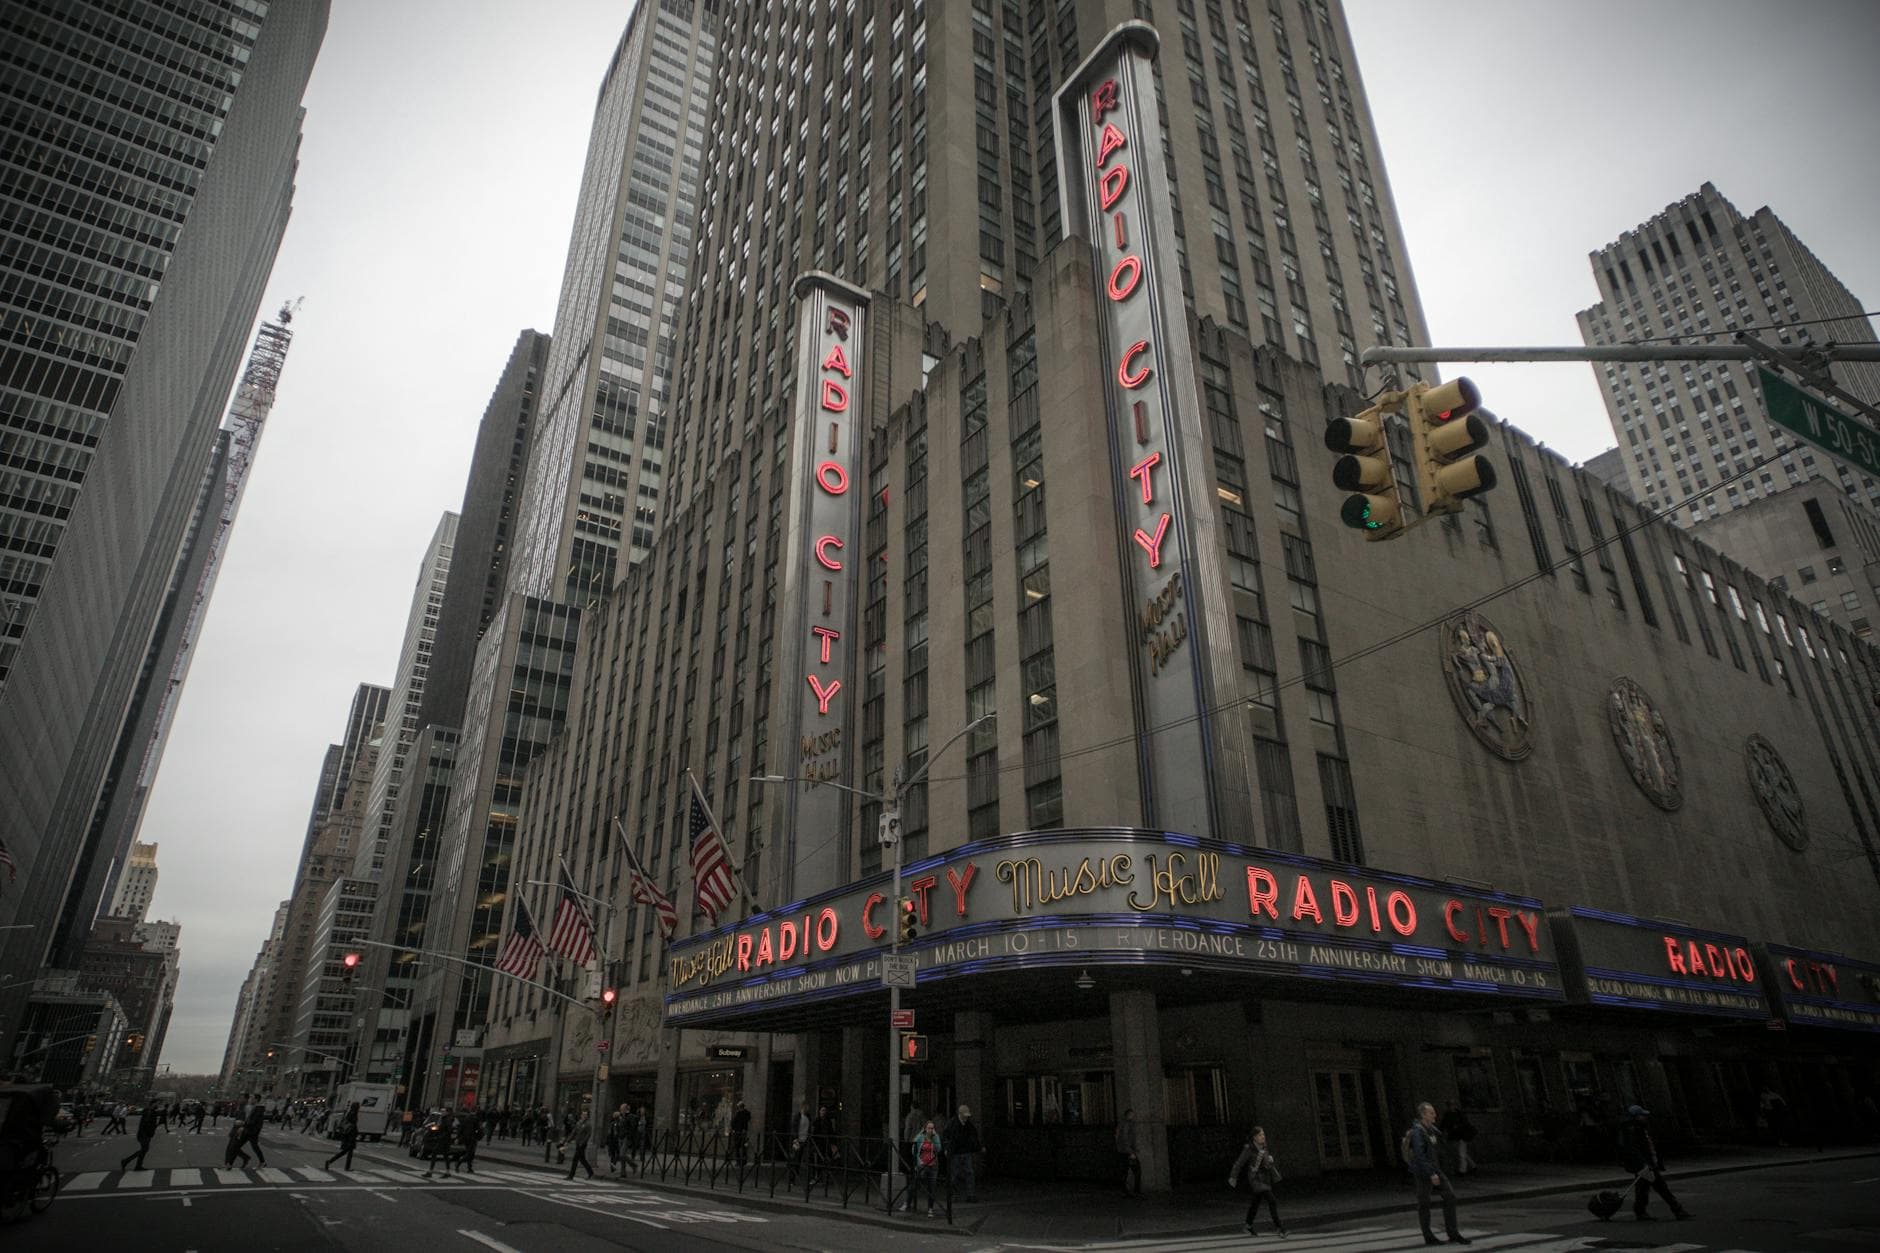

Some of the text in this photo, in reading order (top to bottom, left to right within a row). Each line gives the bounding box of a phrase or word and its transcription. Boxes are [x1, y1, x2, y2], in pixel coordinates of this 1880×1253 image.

[1091, 79, 1172, 569] RADIO CITY
[1801, 400, 1880, 468] W 50 St
[807, 305, 852, 714] RADIO CITY
[996, 852, 1227, 914] Music Hall
[1246, 865, 1540, 953] RADIO CITY
[672, 952, 704, 987] Music
[699, 932, 736, 985] Hall
[737, 907, 839, 972] RADIO
[862, 862, 976, 940] CTY
[735, 979, 792, 1003] ANNIVERSARY
[798, 972, 826, 992] SHOW
[835, 963, 861, 984] NOW
[935, 938, 990, 964] MARCH
[1117, 928, 1245, 956] RIVERDANCE
[1257, 940, 1298, 963] 25TH
[1310, 946, 1407, 973] ANNIVERSARY
[1416, 959, 1453, 978] SHOW
[1464, 963, 1506, 984] MARCH
[1587, 976, 1623, 995] BLOOD
[1663, 936, 1755, 983] RADIO
[1785, 958, 1840, 993] CITY
[718, 1048, 744, 1059] Subway
